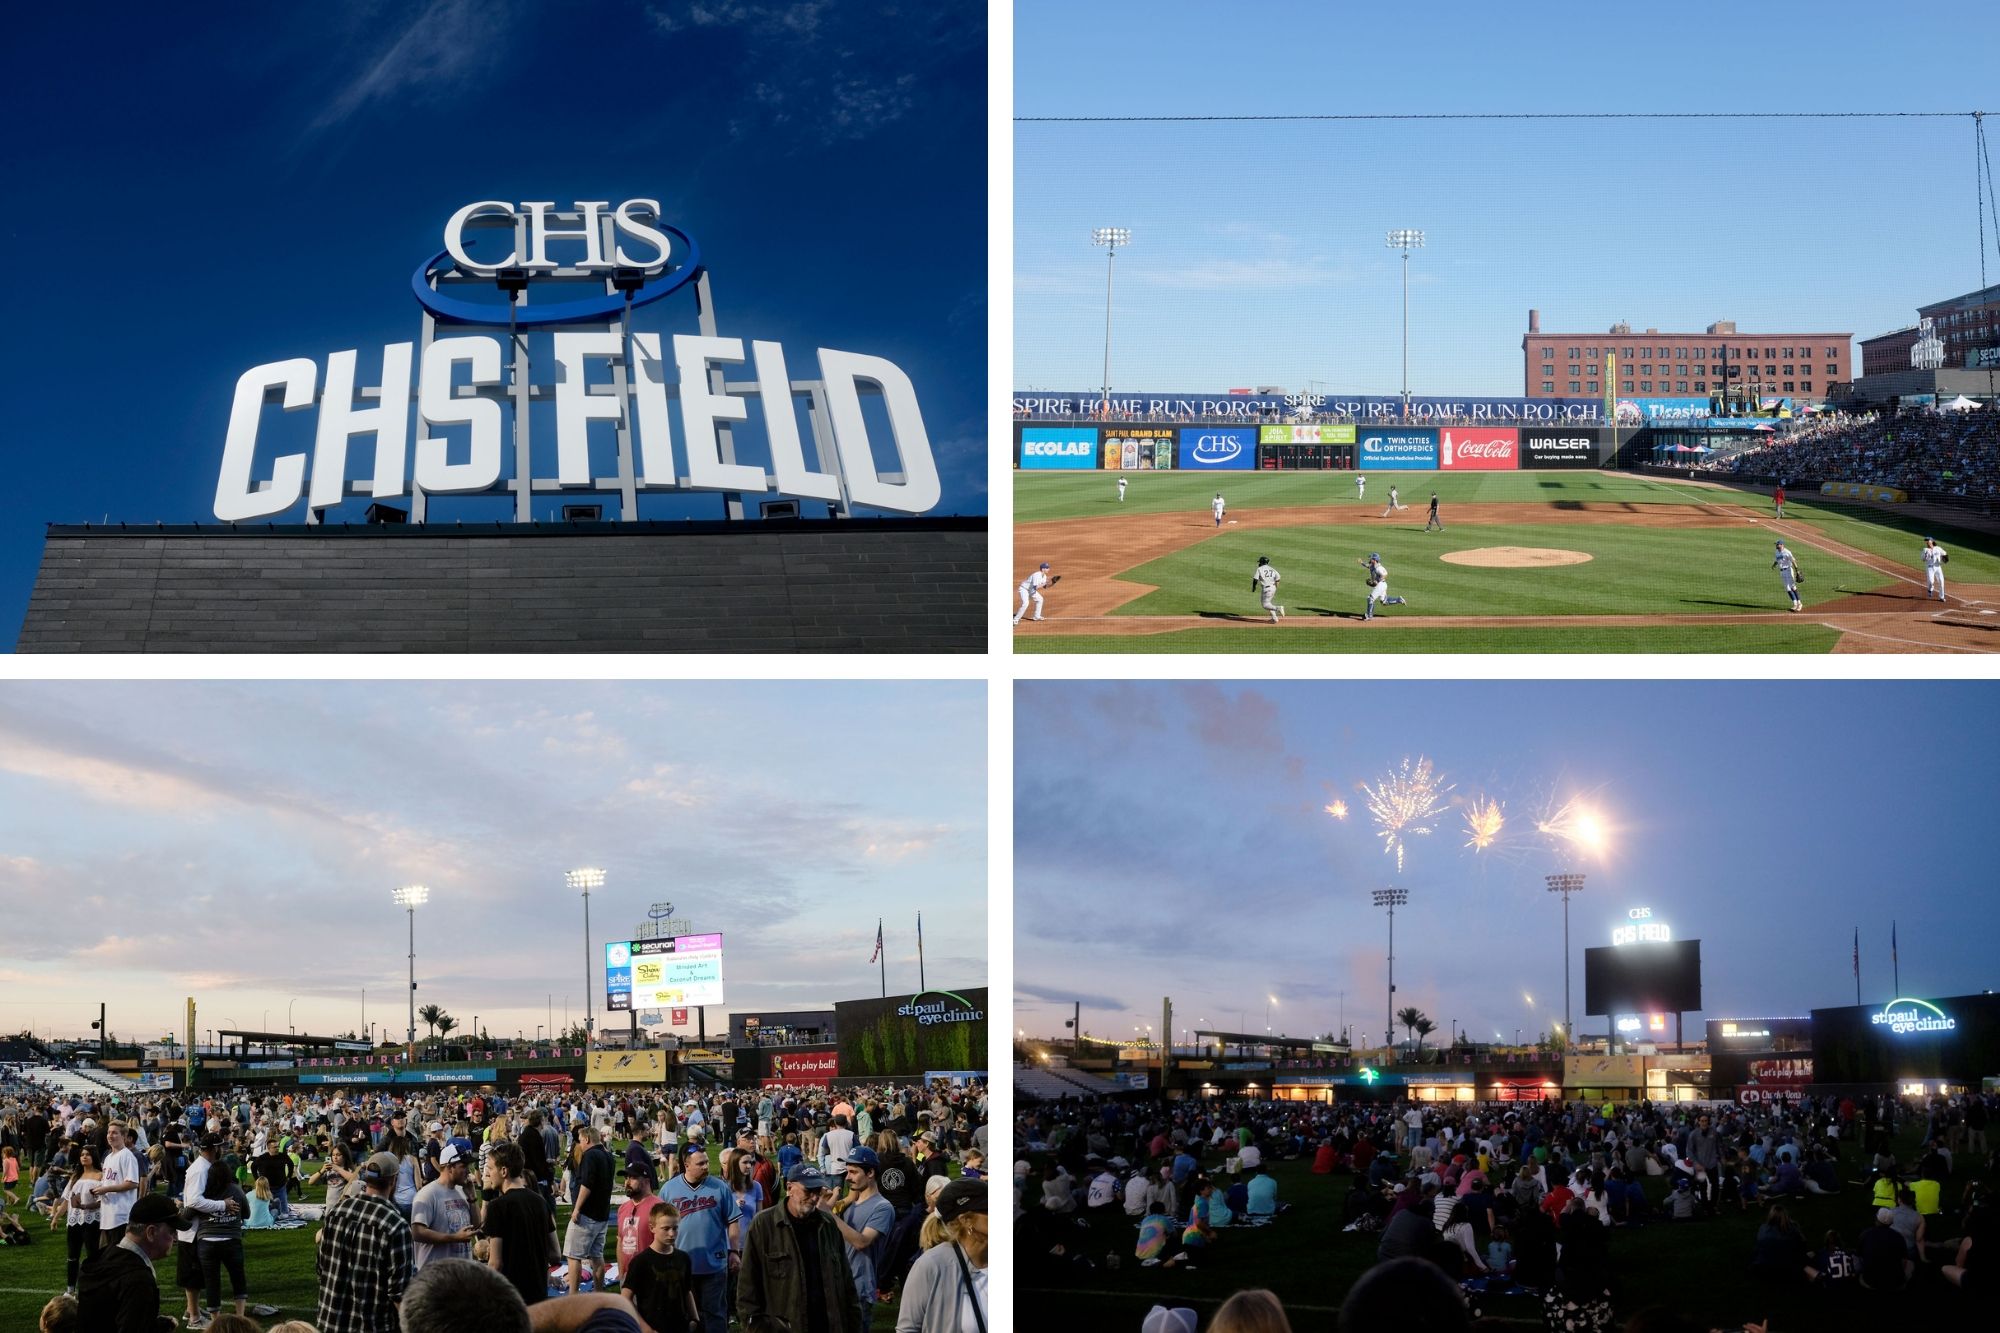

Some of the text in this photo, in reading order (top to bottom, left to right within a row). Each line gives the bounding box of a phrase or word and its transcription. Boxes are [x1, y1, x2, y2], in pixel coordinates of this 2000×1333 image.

[444, 198, 672, 275] CHS
[1013, 398, 1072, 414] SPIRE
[1080, 399, 1142, 414] HOME
[1150, 400, 1195, 415] RUN
[1284, 394, 1326, 406] SPIRE
[1334, 402, 1395, 418] SPIRE
[1472, 404, 1517, 420] RUN
[1524, 404, 1597, 420] PORCH
[213, 332, 942, 522] CHS FIELD
[1024, 442, 1090, 456] ECOLAB
[1198, 435, 1237, 452] CHS
[1457, 440, 1514, 458] Coca-Cola
[1530, 438, 1590, 450] WALSER
[1629, 908, 1650, 919] CHS
[642, 942, 674, 950] securian
[914, 1001, 945, 1017] paul
[919, 1007, 983, 1025] eye clinic
[1888, 1009, 1918, 1024] paul
[1892, 1016, 1955, 1033] eye clinic
[297, 1055, 401, 1067] TREASURE
[467, 1048, 583, 1061] ISLAND
[1445, 1052, 1561, 1064] ISLAND
[784, 1059, 836, 1072] Let's play ball!
[1760, 1068, 1776, 1076] Let's
[1777, 1068, 1792, 1078] play
[1089, 1187, 1102, 1200] 76
[672, 1195, 716, 1213] Twins
